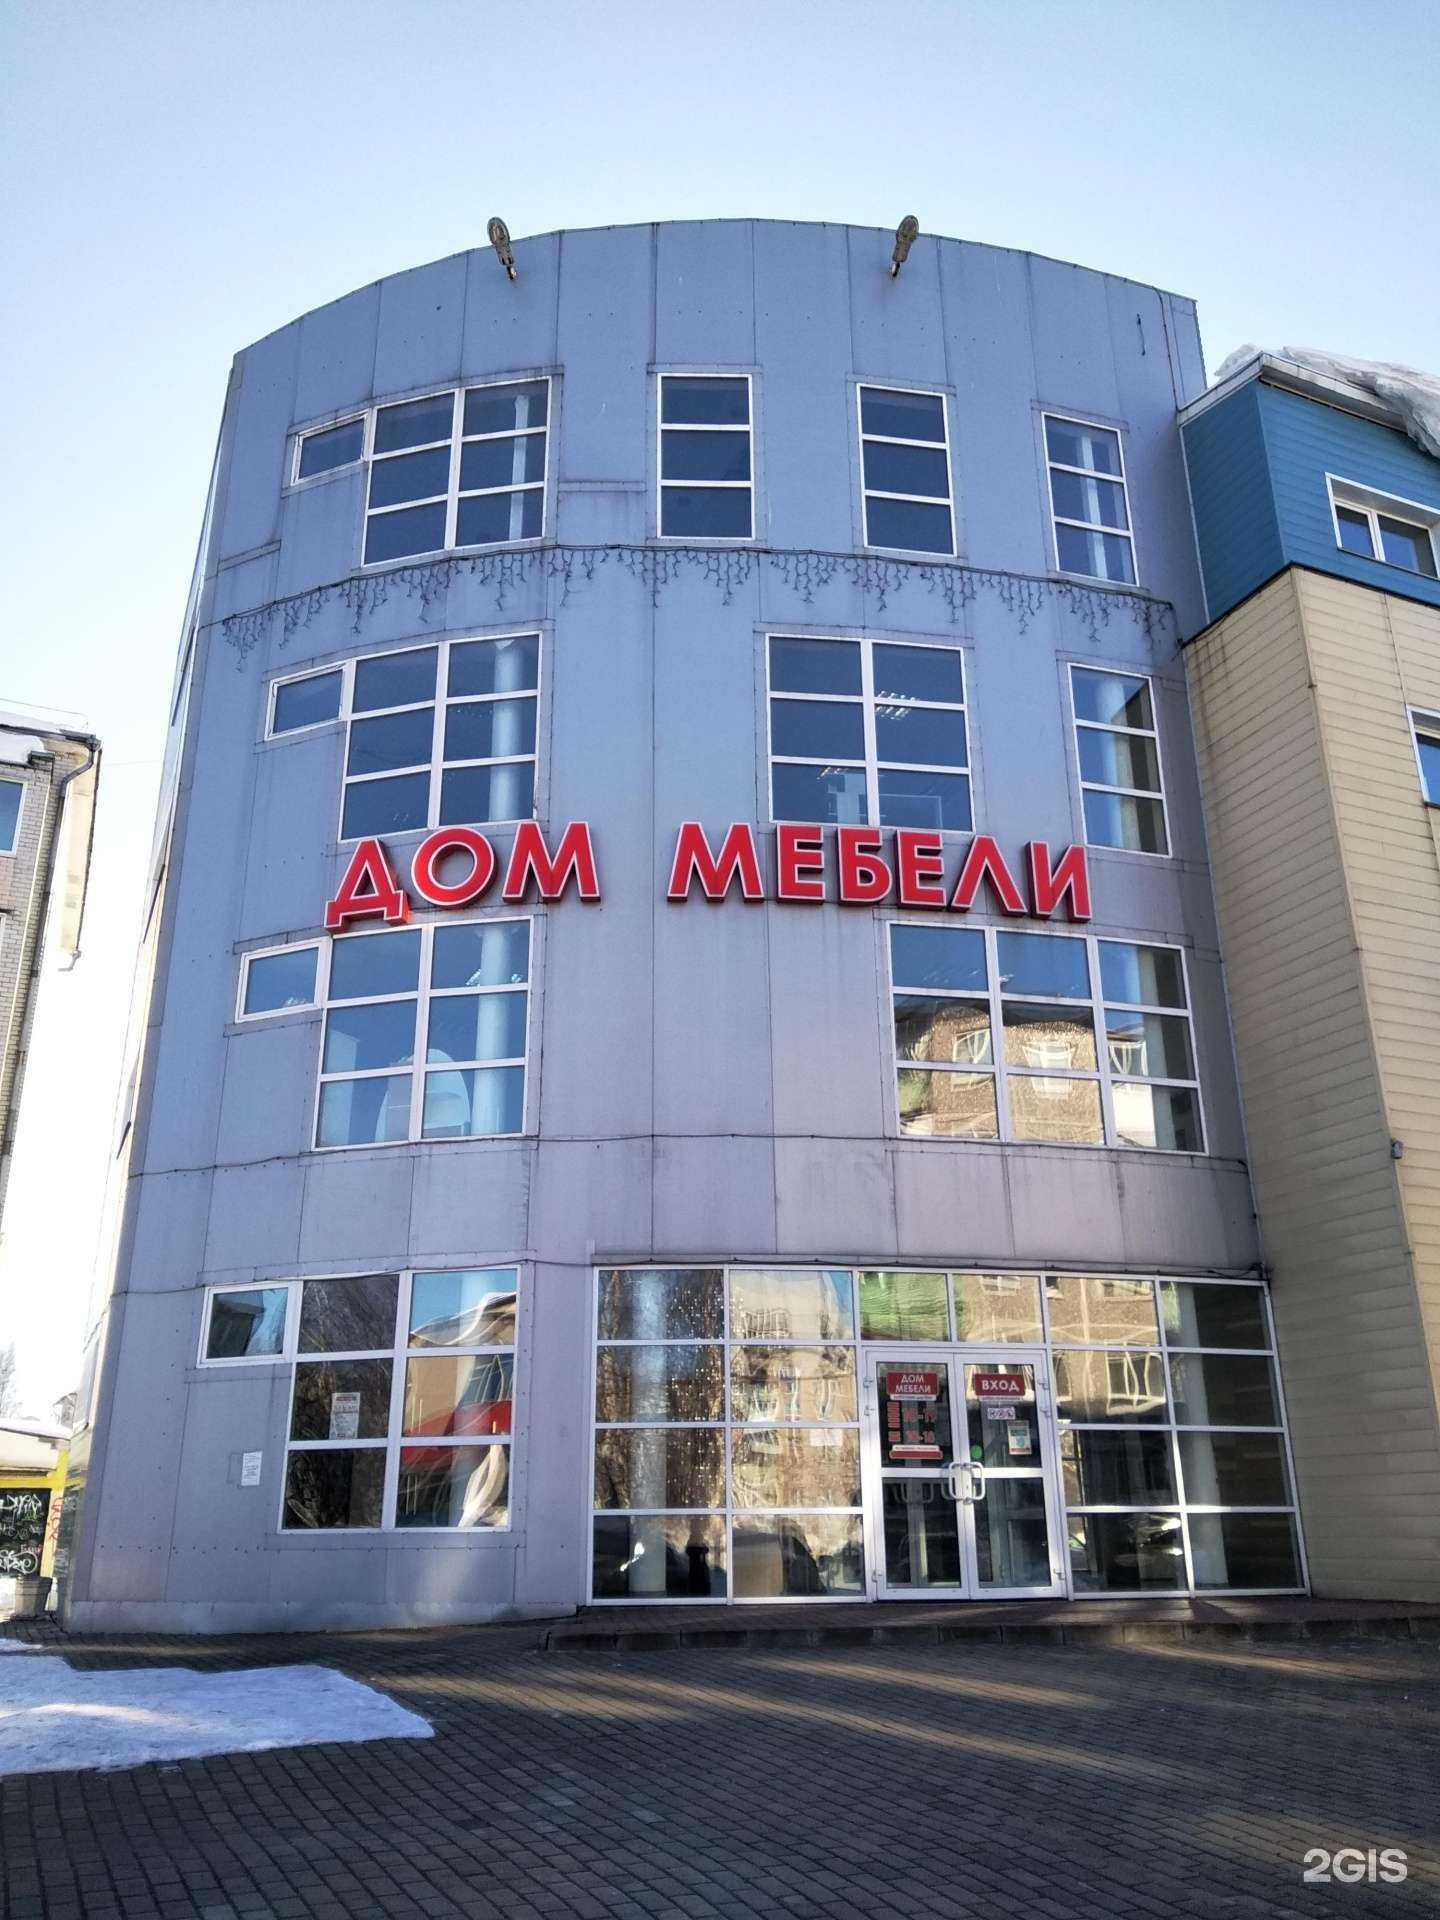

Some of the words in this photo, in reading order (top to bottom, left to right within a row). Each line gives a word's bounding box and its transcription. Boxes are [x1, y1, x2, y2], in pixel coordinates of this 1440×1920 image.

[324, 821, 601, 932] ДОМ
[666, 821, 1093, 923] МЕБЕЛИ
[901, 1374, 924, 1384] ДОМ
[895, 1384, 931, 1393] МЕБЕЛИ
[981, 1380, 1020, 1392] ВХОД
